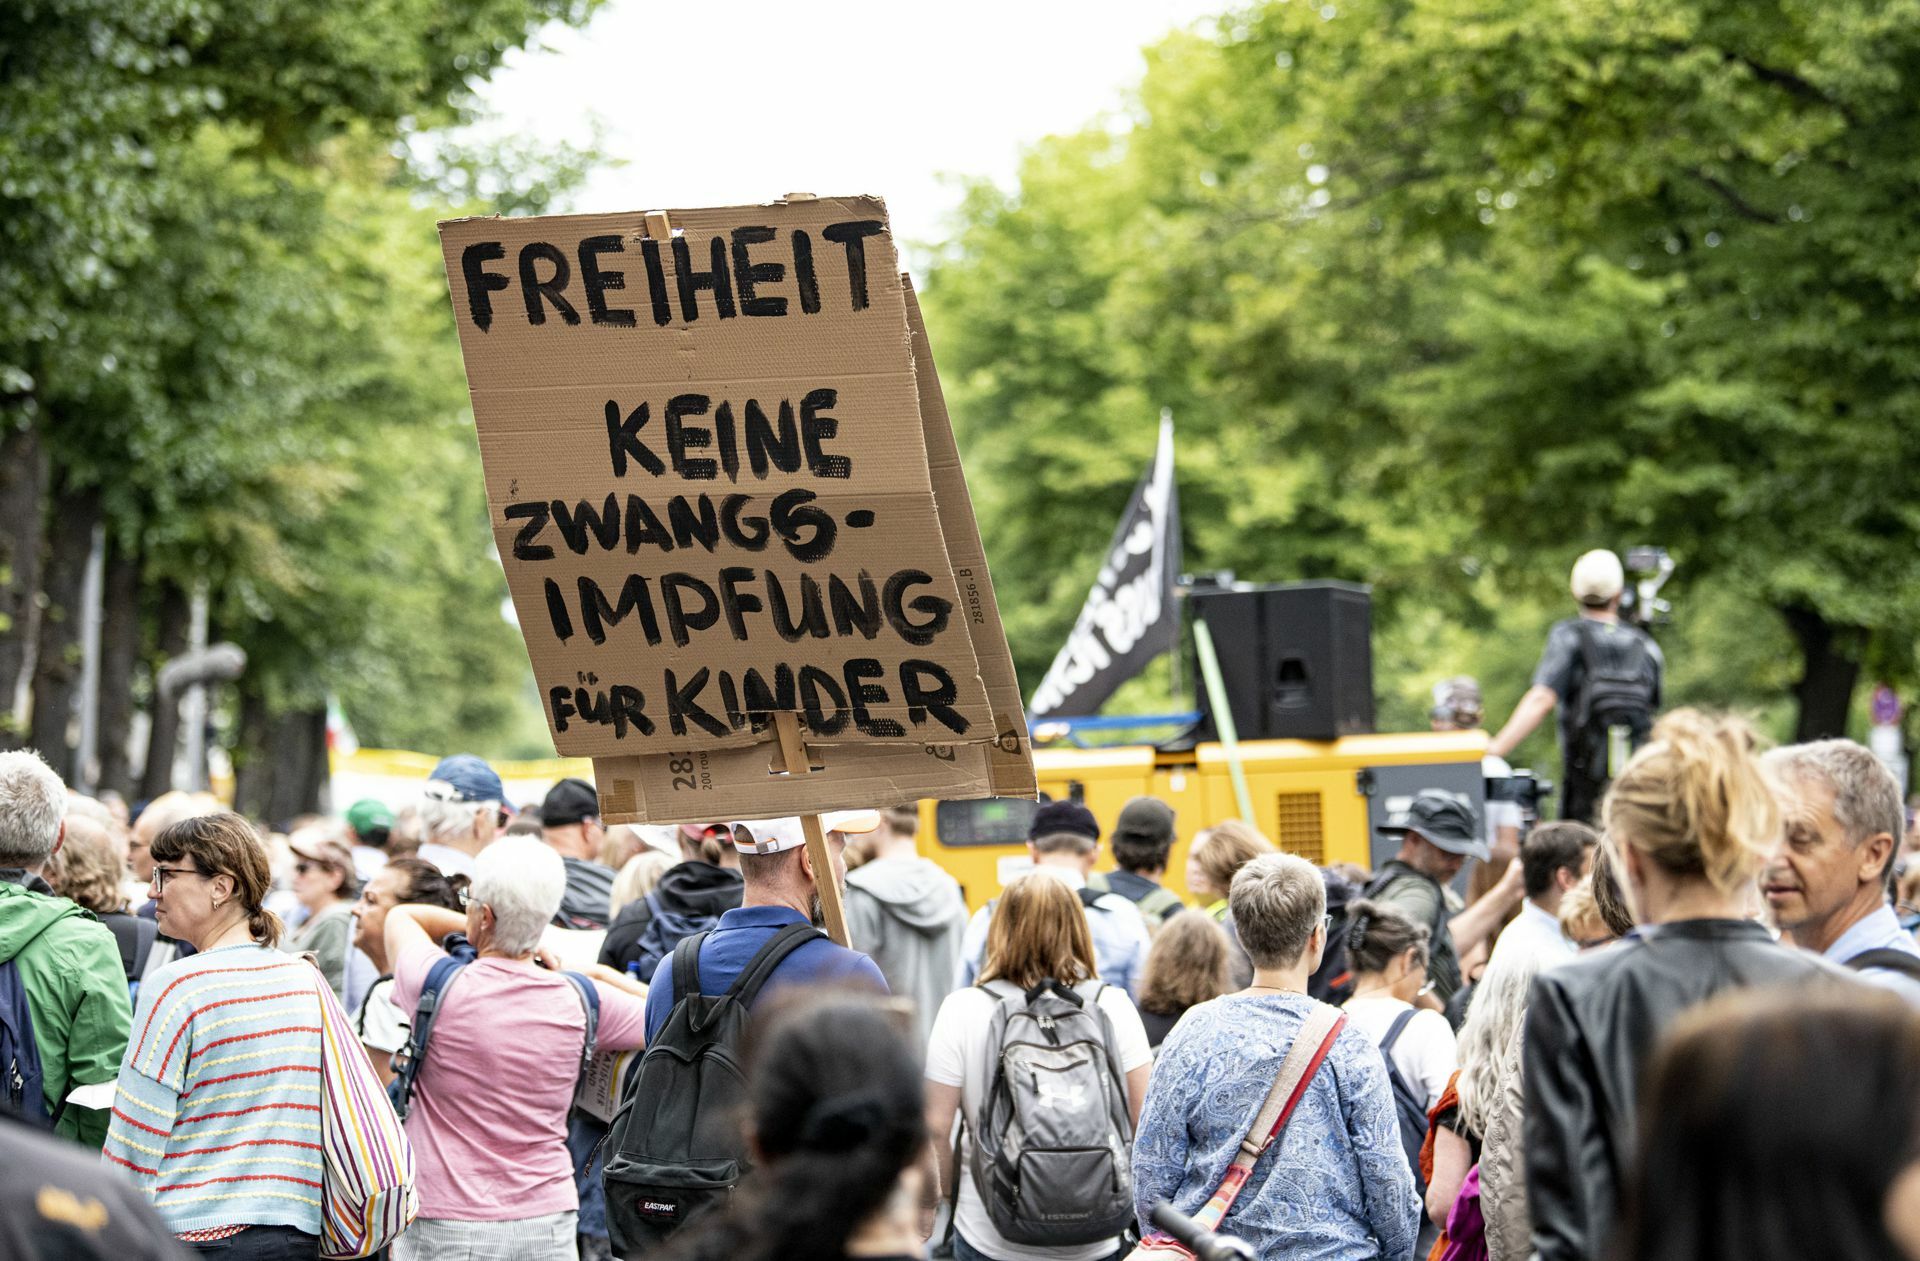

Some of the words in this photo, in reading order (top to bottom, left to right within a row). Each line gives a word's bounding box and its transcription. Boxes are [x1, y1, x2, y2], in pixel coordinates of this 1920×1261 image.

[461, 219, 886, 334] FREIHEIT
[604, 388, 853, 484] KEINE
[543, 567, 954, 649] IMPFUNG
[959, 568, 985, 625] 281856.B
[549, 670, 657, 740] FÜR
[663, 657, 972, 738] KINDER
[669, 751, 697, 791] 28
[700, 750, 710, 771] rou
[701, 772, 713, 791] 200
[644, 1201, 675, 1212] EASTPAK
